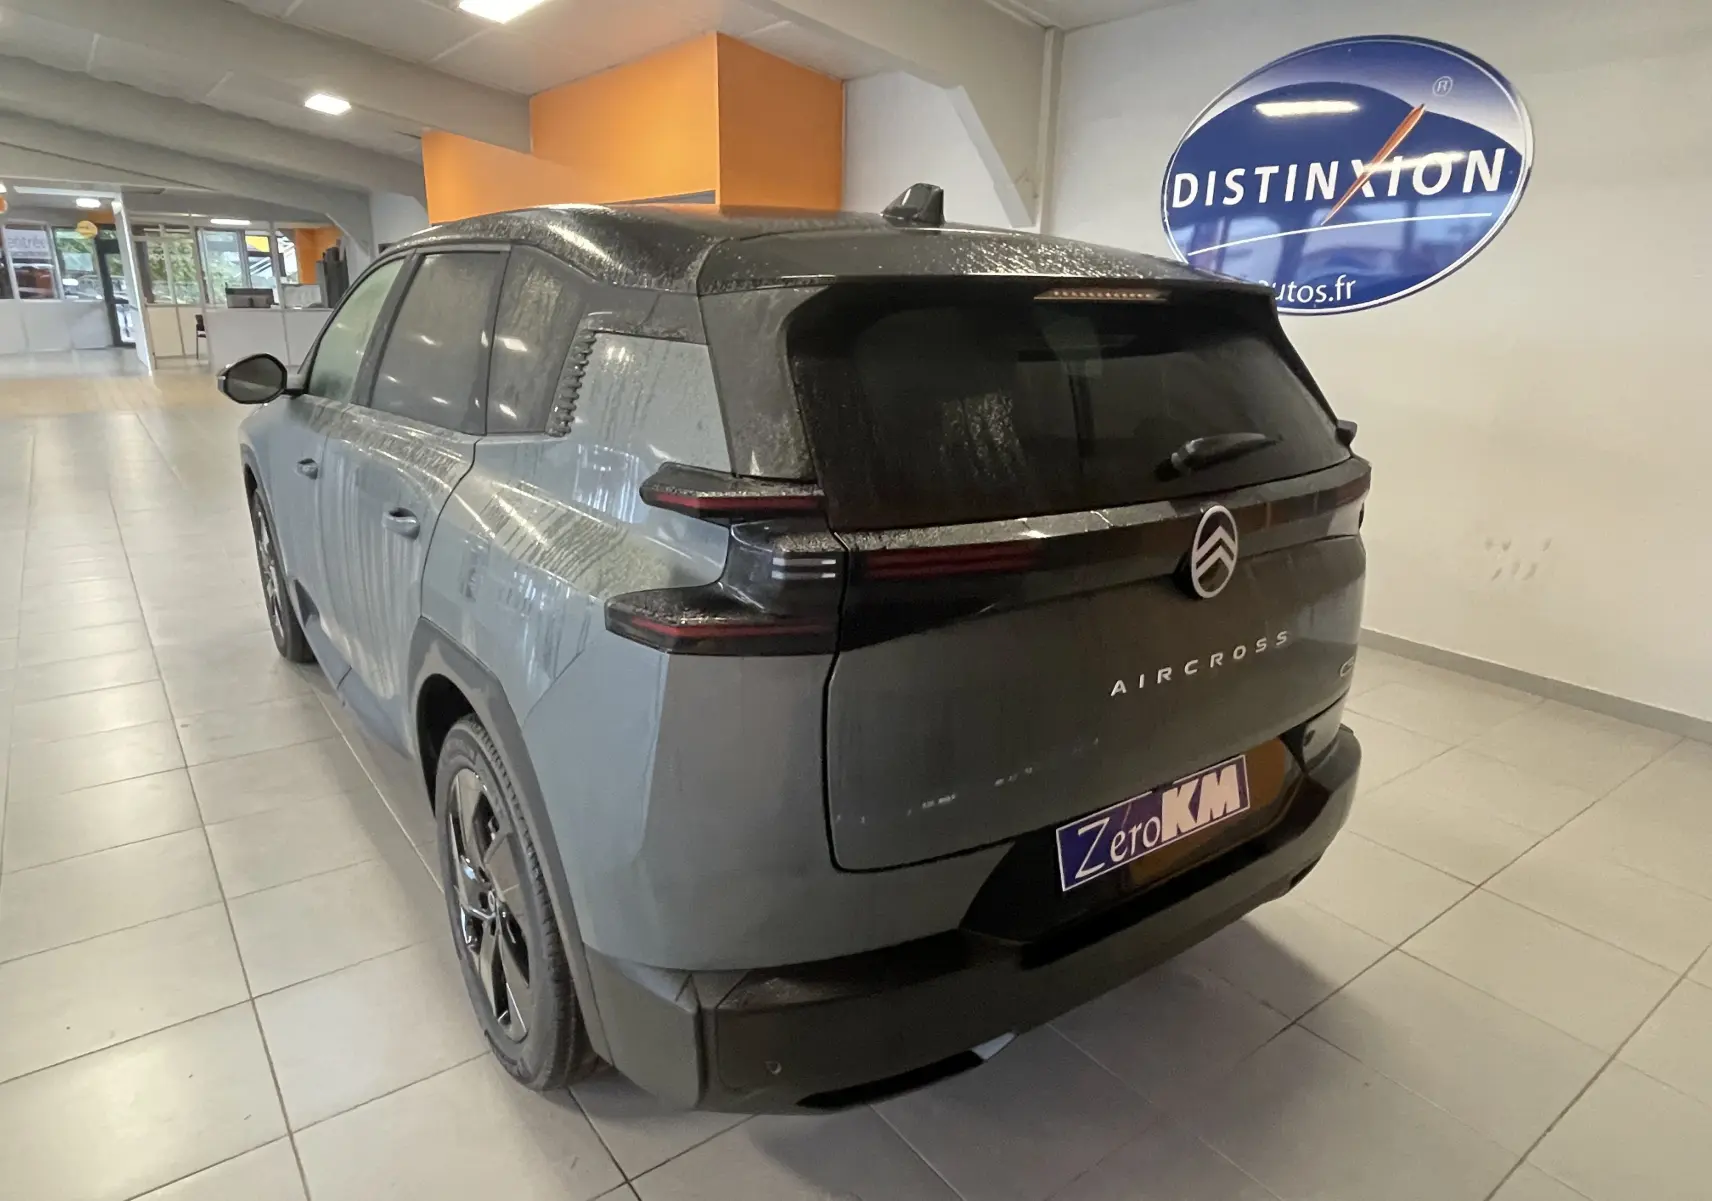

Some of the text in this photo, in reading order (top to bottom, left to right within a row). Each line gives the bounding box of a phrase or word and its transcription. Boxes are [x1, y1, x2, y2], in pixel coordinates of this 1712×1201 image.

[1171, 146, 1506, 210] DISTINXION
[1258, 274, 1356, 304] utos.fr
[1110, 630, 1289, 697] AIRCROSS
